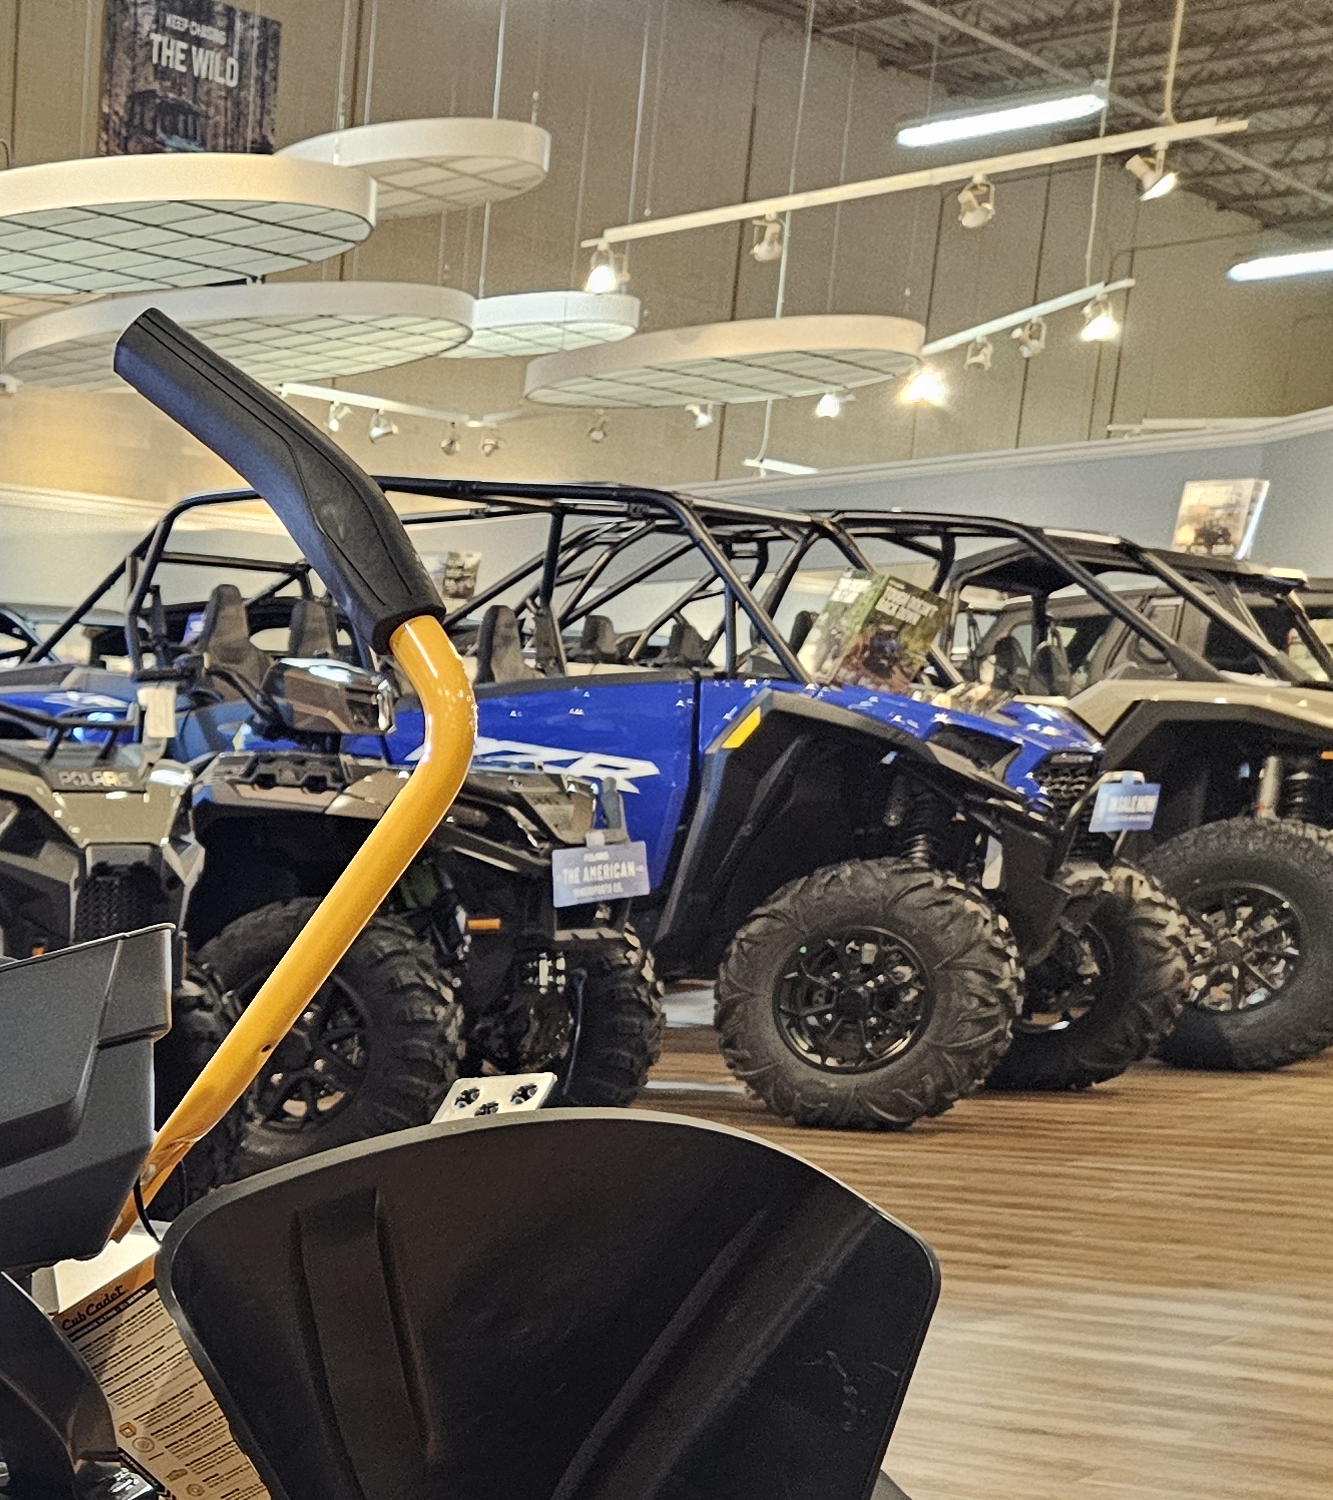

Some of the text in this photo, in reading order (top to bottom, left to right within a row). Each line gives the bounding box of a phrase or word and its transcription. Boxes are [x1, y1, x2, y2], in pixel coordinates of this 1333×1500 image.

[149, 32, 239, 88] THE WILD
[561, 861, 636, 885] THE AMERICAN
[61, 1284, 129, 1331] Cub Cadet
